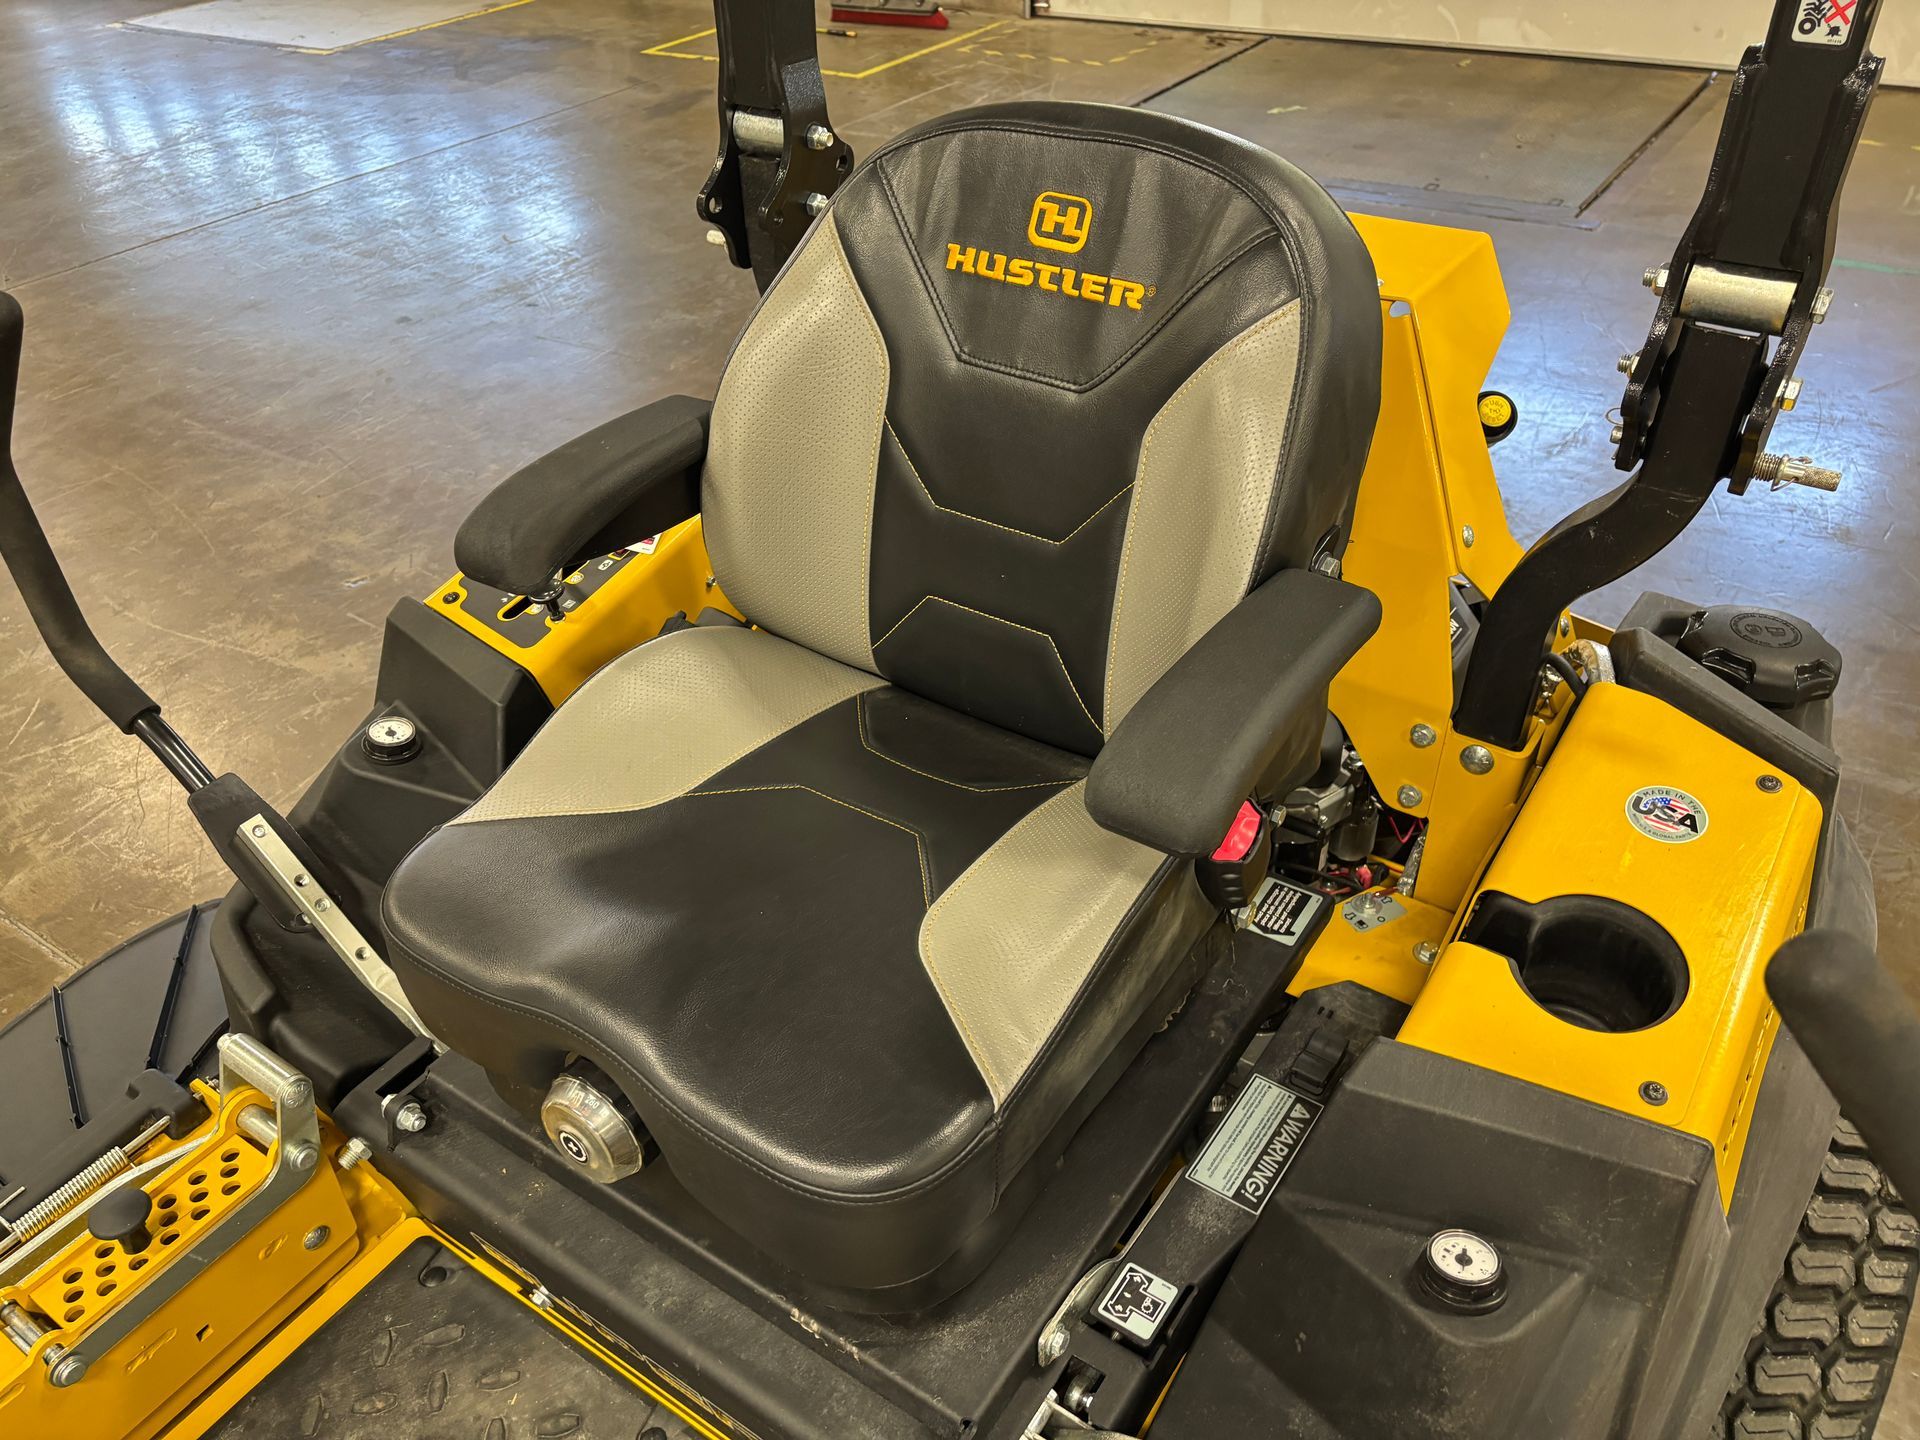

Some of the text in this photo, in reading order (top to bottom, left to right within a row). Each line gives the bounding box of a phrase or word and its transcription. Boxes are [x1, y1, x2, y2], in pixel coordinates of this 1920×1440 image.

[945, 242, 1146, 311] HUSTLER
[1631, 795, 1699, 834] USA
[1642, 789, 1702, 815] MADE IN THE
[1239, 1118, 1304, 1202] WARNING!
